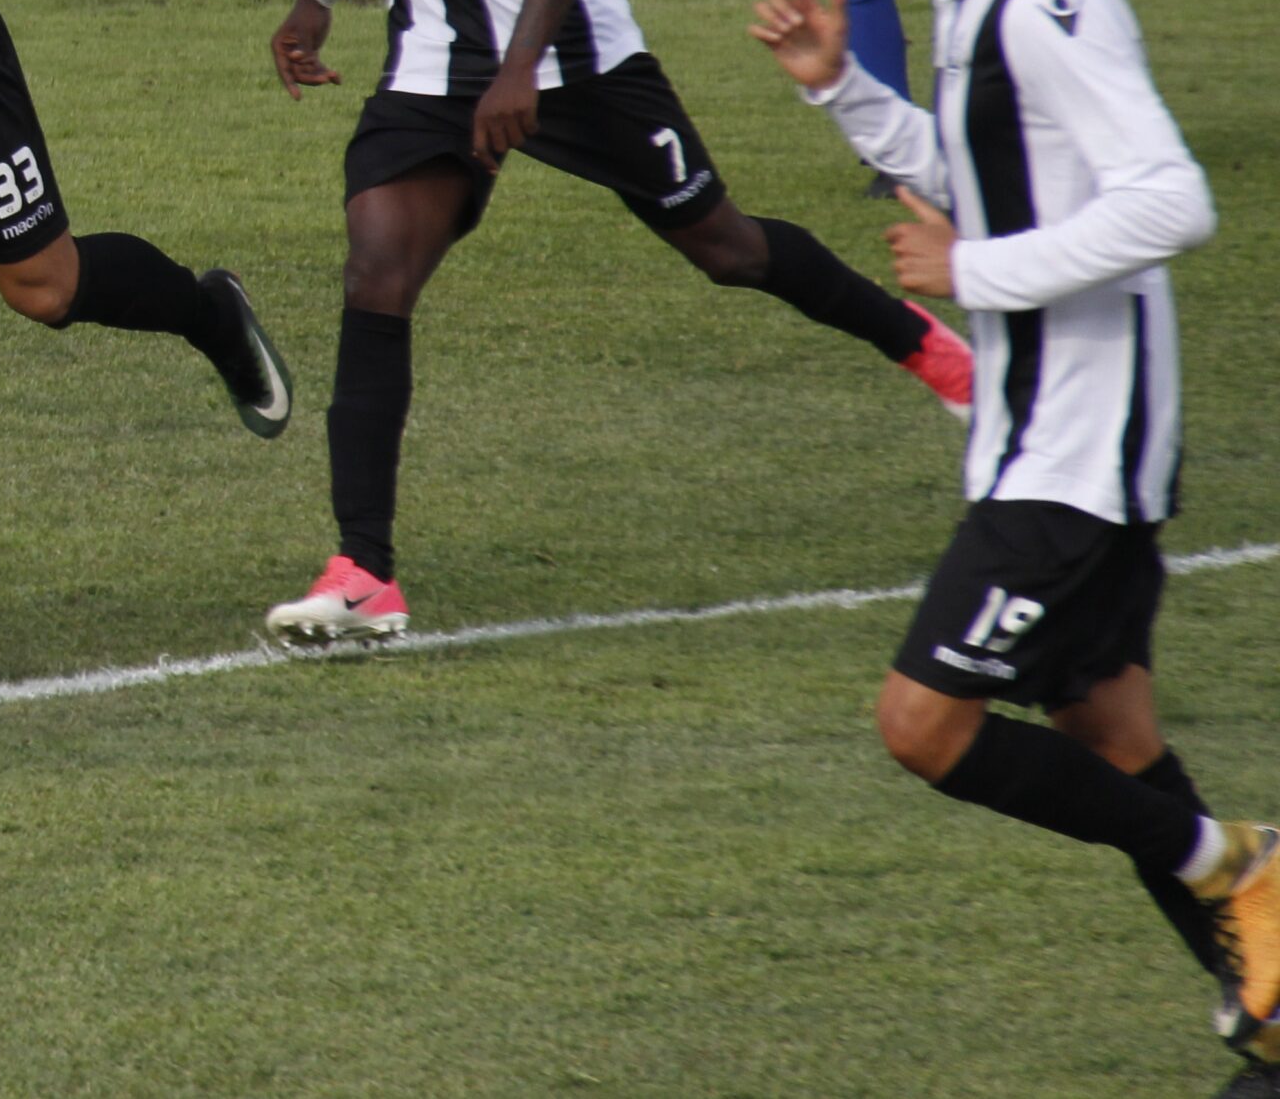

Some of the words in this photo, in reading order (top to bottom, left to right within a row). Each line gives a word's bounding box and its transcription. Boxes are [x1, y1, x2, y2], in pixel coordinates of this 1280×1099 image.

[650, 127, 688, 183] 7
[1, 202, 55, 240] macron
[963, 585, 1045, 653] 19
